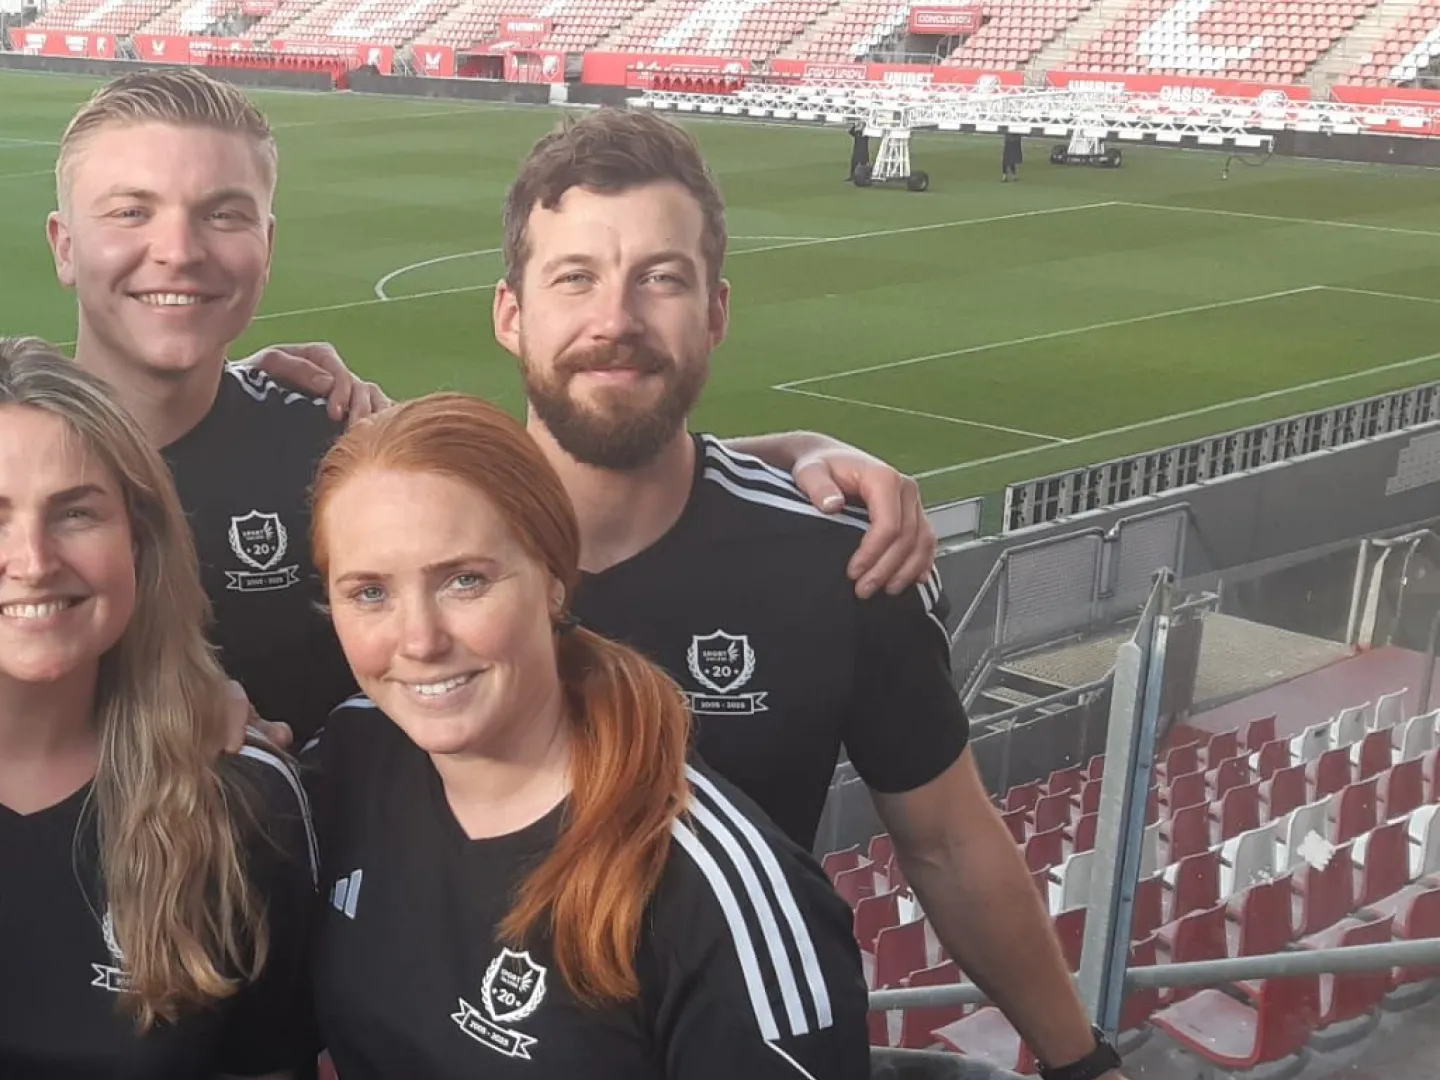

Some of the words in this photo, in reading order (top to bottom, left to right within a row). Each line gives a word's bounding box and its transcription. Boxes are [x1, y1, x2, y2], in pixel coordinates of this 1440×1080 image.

[252, 543, 270, 555] 20
[712, 666, 731, 678] 20
[497, 988, 516, 1006] 20
